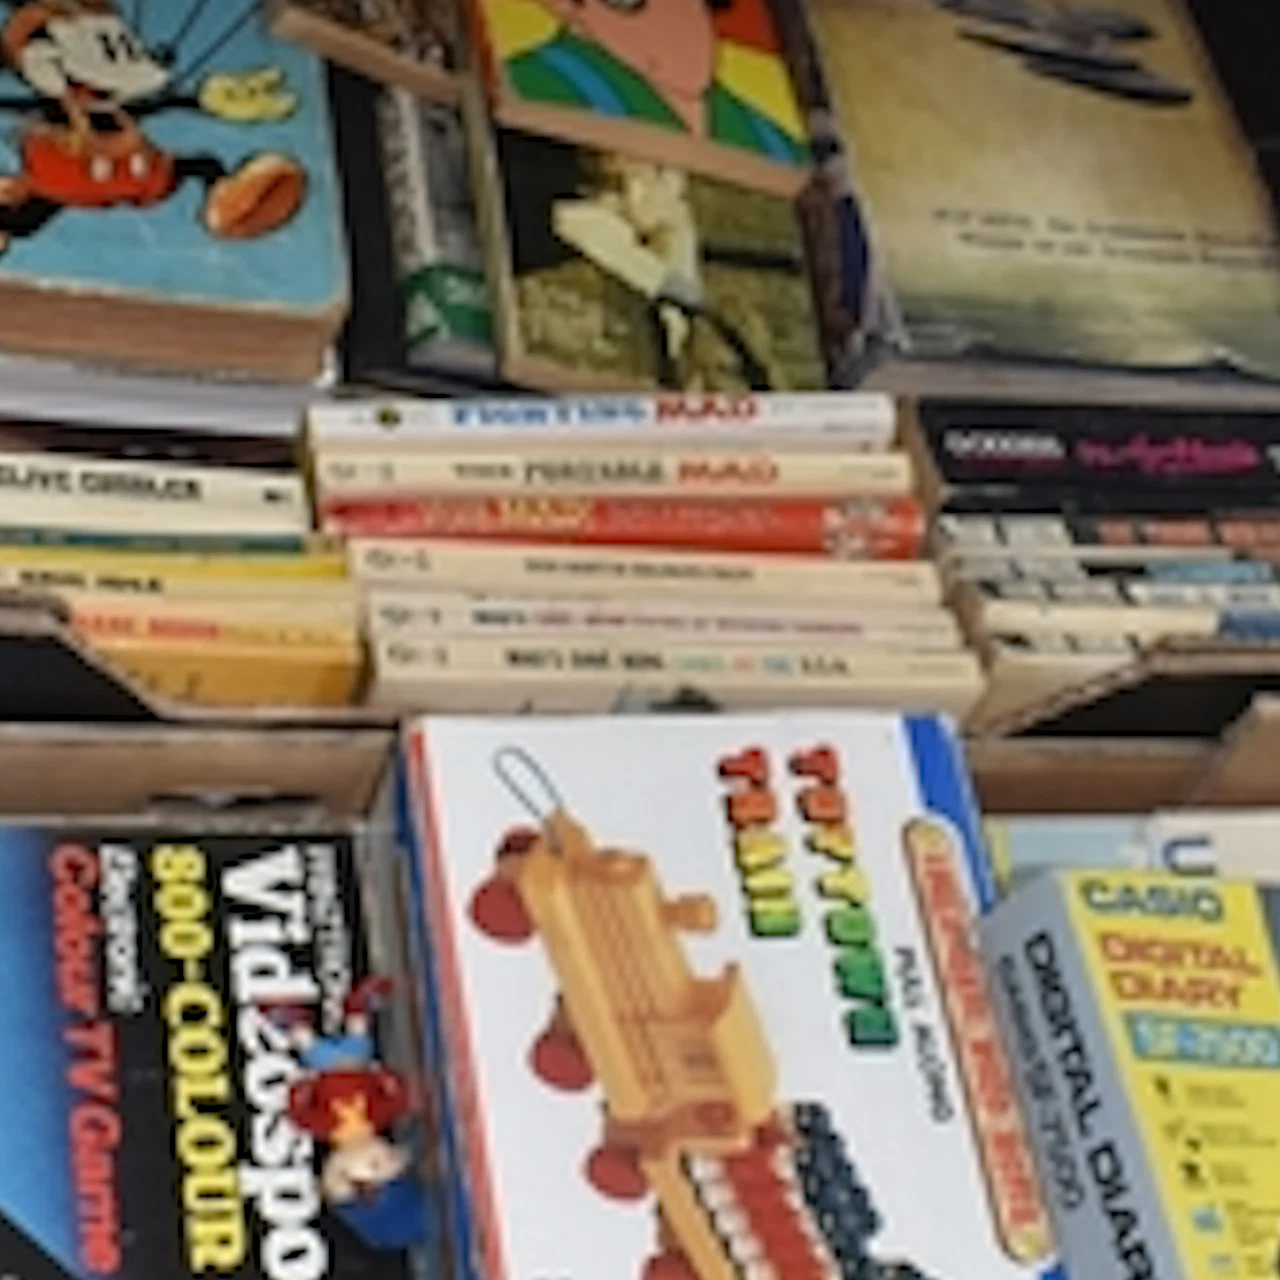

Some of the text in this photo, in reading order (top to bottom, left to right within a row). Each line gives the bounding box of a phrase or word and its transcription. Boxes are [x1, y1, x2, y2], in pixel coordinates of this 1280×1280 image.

[656, 395, 762, 424] MAD
[716, 746, 801, 939] TRAIN
[786, 745, 902, 1051] TOYTOWN
[1079, 875, 1225, 923] CASIO
[1023, 930, 1102, 1138] DIGITAL
[1098, 931, 1264, 978] DIGITAL
[1109, 970, 1244, 1010] DIARY
[50, 843, 120, 1274] Colour TV Game
[152, 841, 245, 1275] 800-COLOUR
